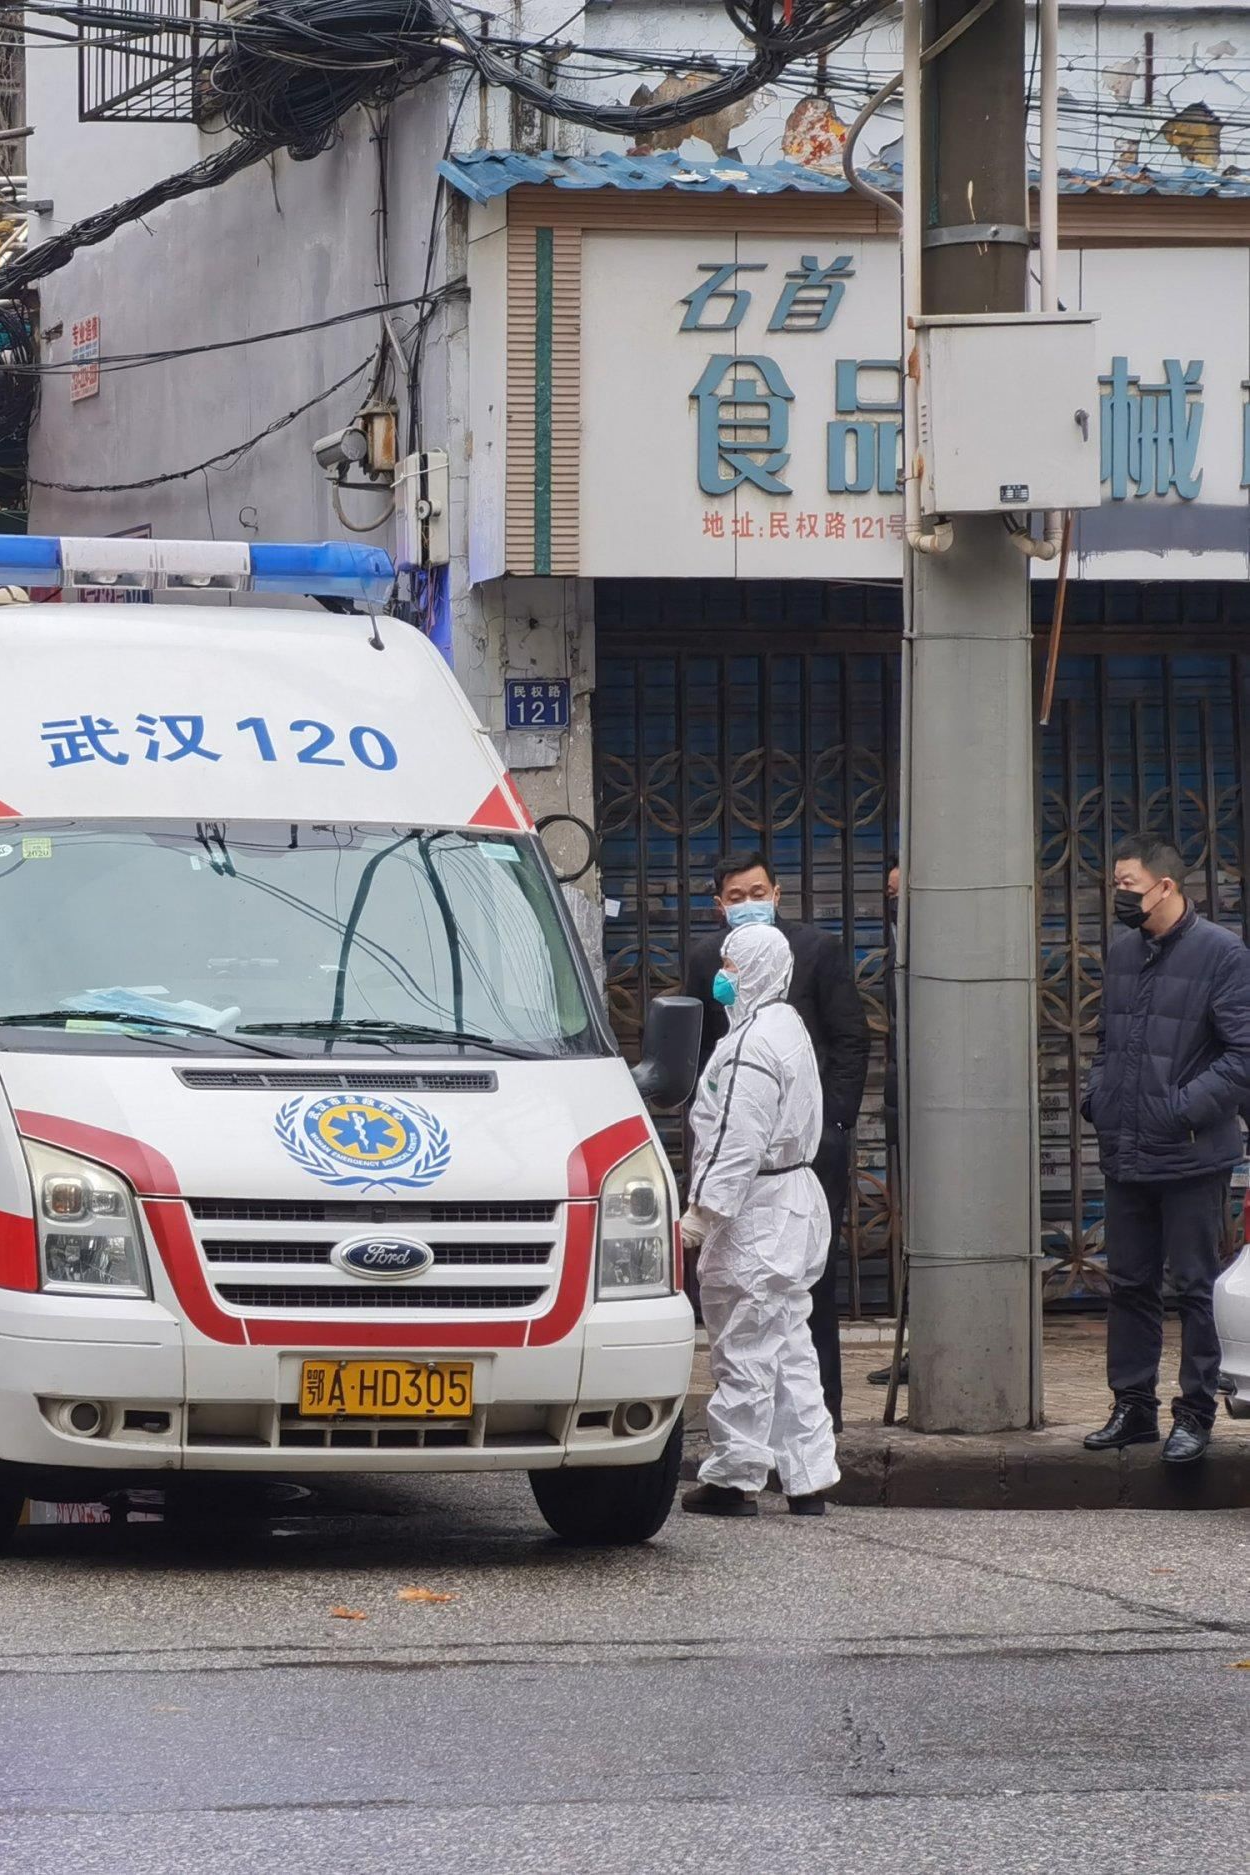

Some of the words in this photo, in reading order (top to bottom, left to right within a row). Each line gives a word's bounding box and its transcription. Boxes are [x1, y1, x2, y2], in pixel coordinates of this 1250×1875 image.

[678, 254, 855, 332] 石首
[514, 685, 561, 698] 民权路
[517, 701, 560, 724] 121
[41, 713, 399, 771] 武汉120
[307, 1095, 405, 1122] 武汉市急救中心
[331, 1150, 380, 1168] EMERGENCY
[361, 1241, 411, 1265] Ford
